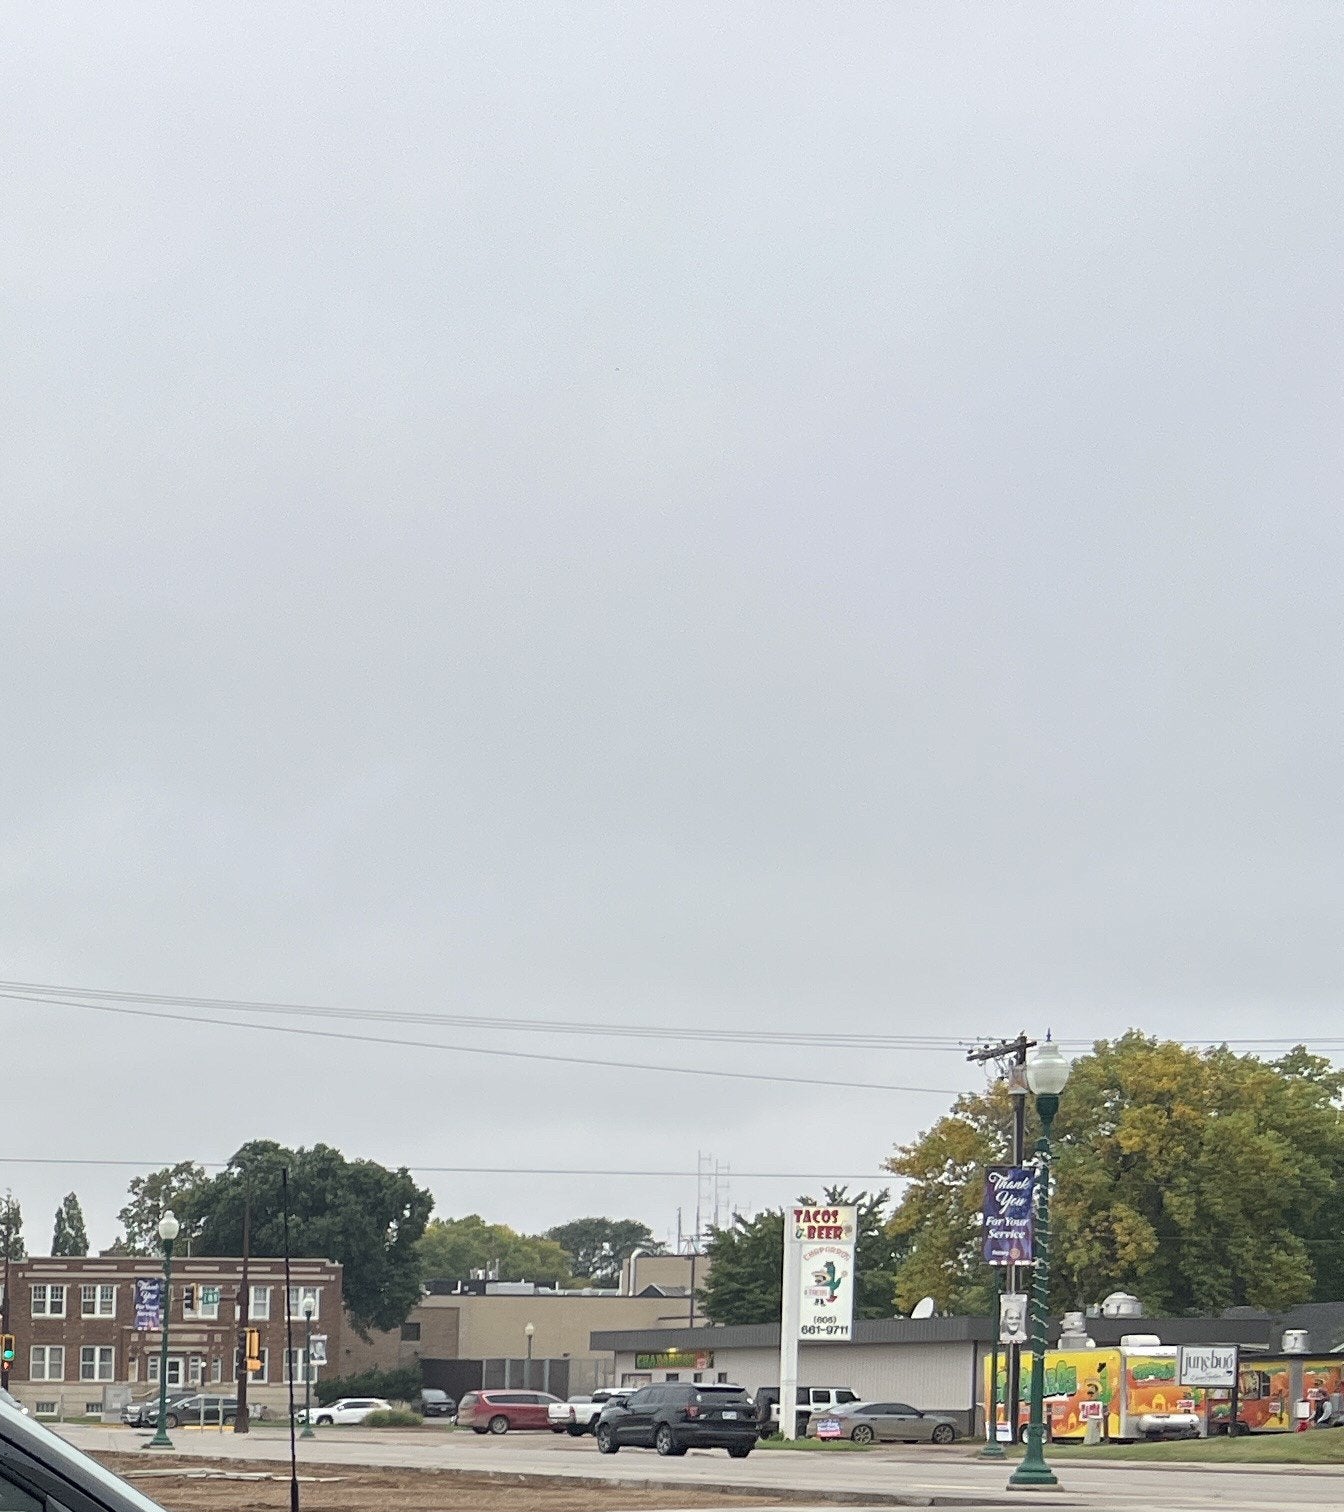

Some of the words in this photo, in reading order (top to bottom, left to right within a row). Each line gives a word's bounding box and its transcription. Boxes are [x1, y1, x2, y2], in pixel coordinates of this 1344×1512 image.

[988, 1171, 1031, 1192] Thank
[994, 1191, 1027, 1215] You
[793, 1209, 839, 1223] TACOS
[985, 1216, 1003, 1226] For
[1005, 1216, 1030, 1226] Your
[807, 1225, 844, 1240] BEER
[987, 1229, 1026, 1240] Service
